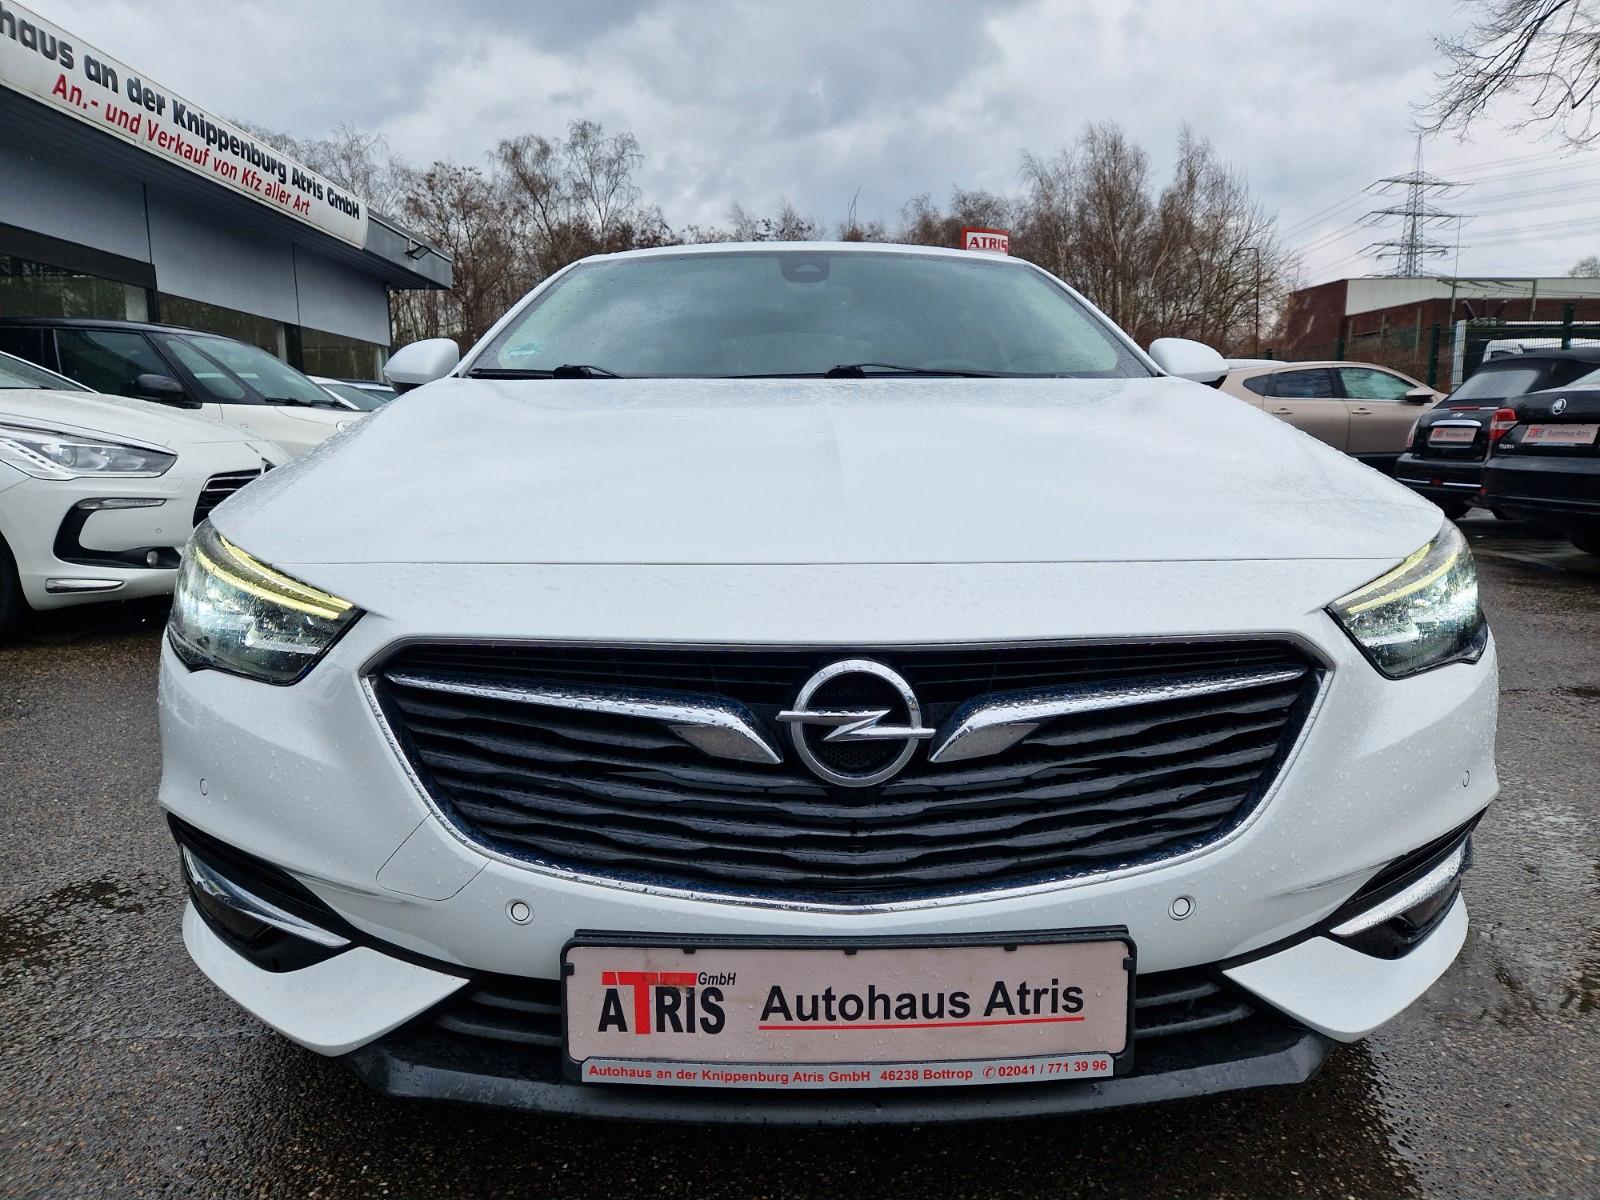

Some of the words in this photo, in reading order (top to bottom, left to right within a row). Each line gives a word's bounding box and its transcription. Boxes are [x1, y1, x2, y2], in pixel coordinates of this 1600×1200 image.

[84, 54, 119, 94] an
[126, 77, 166, 116] der
[171, 98, 287, 185] Knippenburg
[291, 166, 324, 201] Atris
[326, 187, 360, 220] GmbH
[105, 103, 142, 135] und
[147, 119, 210, 167] Verkauf
[213, 157, 238, 181] von
[241, 167, 263, 192] Kfz
[264, 180, 292, 206] aller
[293, 198, 311, 216] Art
[968, 236, 1008, 253] ATRIS
[698, 972, 736, 986] GmbH
[759, 984, 970, 1023] Autohaus
[983, 978, 1084, 1017] Atris
[597, 971, 726, 1035] ATRIS
[588, 1064, 652, 1079] Autohaus
[656, 1070, 672, 1079] an
[676, 1069, 697, 1080] der
[702, 1070, 789, 1085] Knippenburg
[793, 1071, 825, 1082] Atris
[829, 1071, 871, 1082] GmbH
[880, 1069, 919, 1081] 46238
[923, 1069, 973, 1081] Bottrop
[998, 1064, 1035, 1077] 02041
[1048, 1062, 1069, 1074] 771
[1074, 1061, 1089, 1072] 39
[1092, 1060, 1108, 1071] 96
